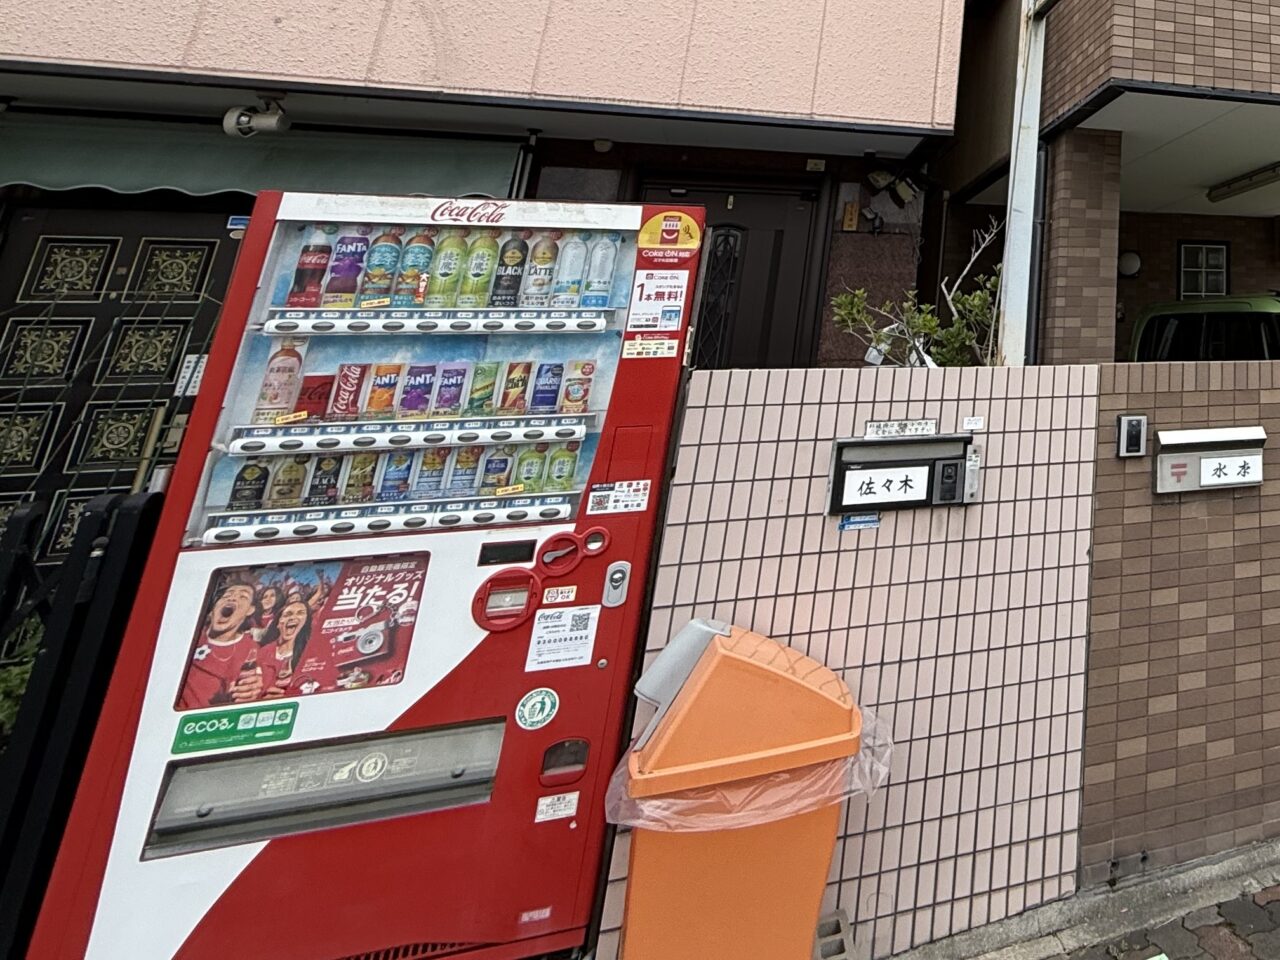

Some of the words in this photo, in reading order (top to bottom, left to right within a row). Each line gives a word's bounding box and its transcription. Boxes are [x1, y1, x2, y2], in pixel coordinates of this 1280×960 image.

[336, 242, 367, 253] FANTA
[642, 249, 664, 258] Coke
[857, 474, 914, 497] 佐々木
[344, 569, 426, 586] オリジナルグッズ
